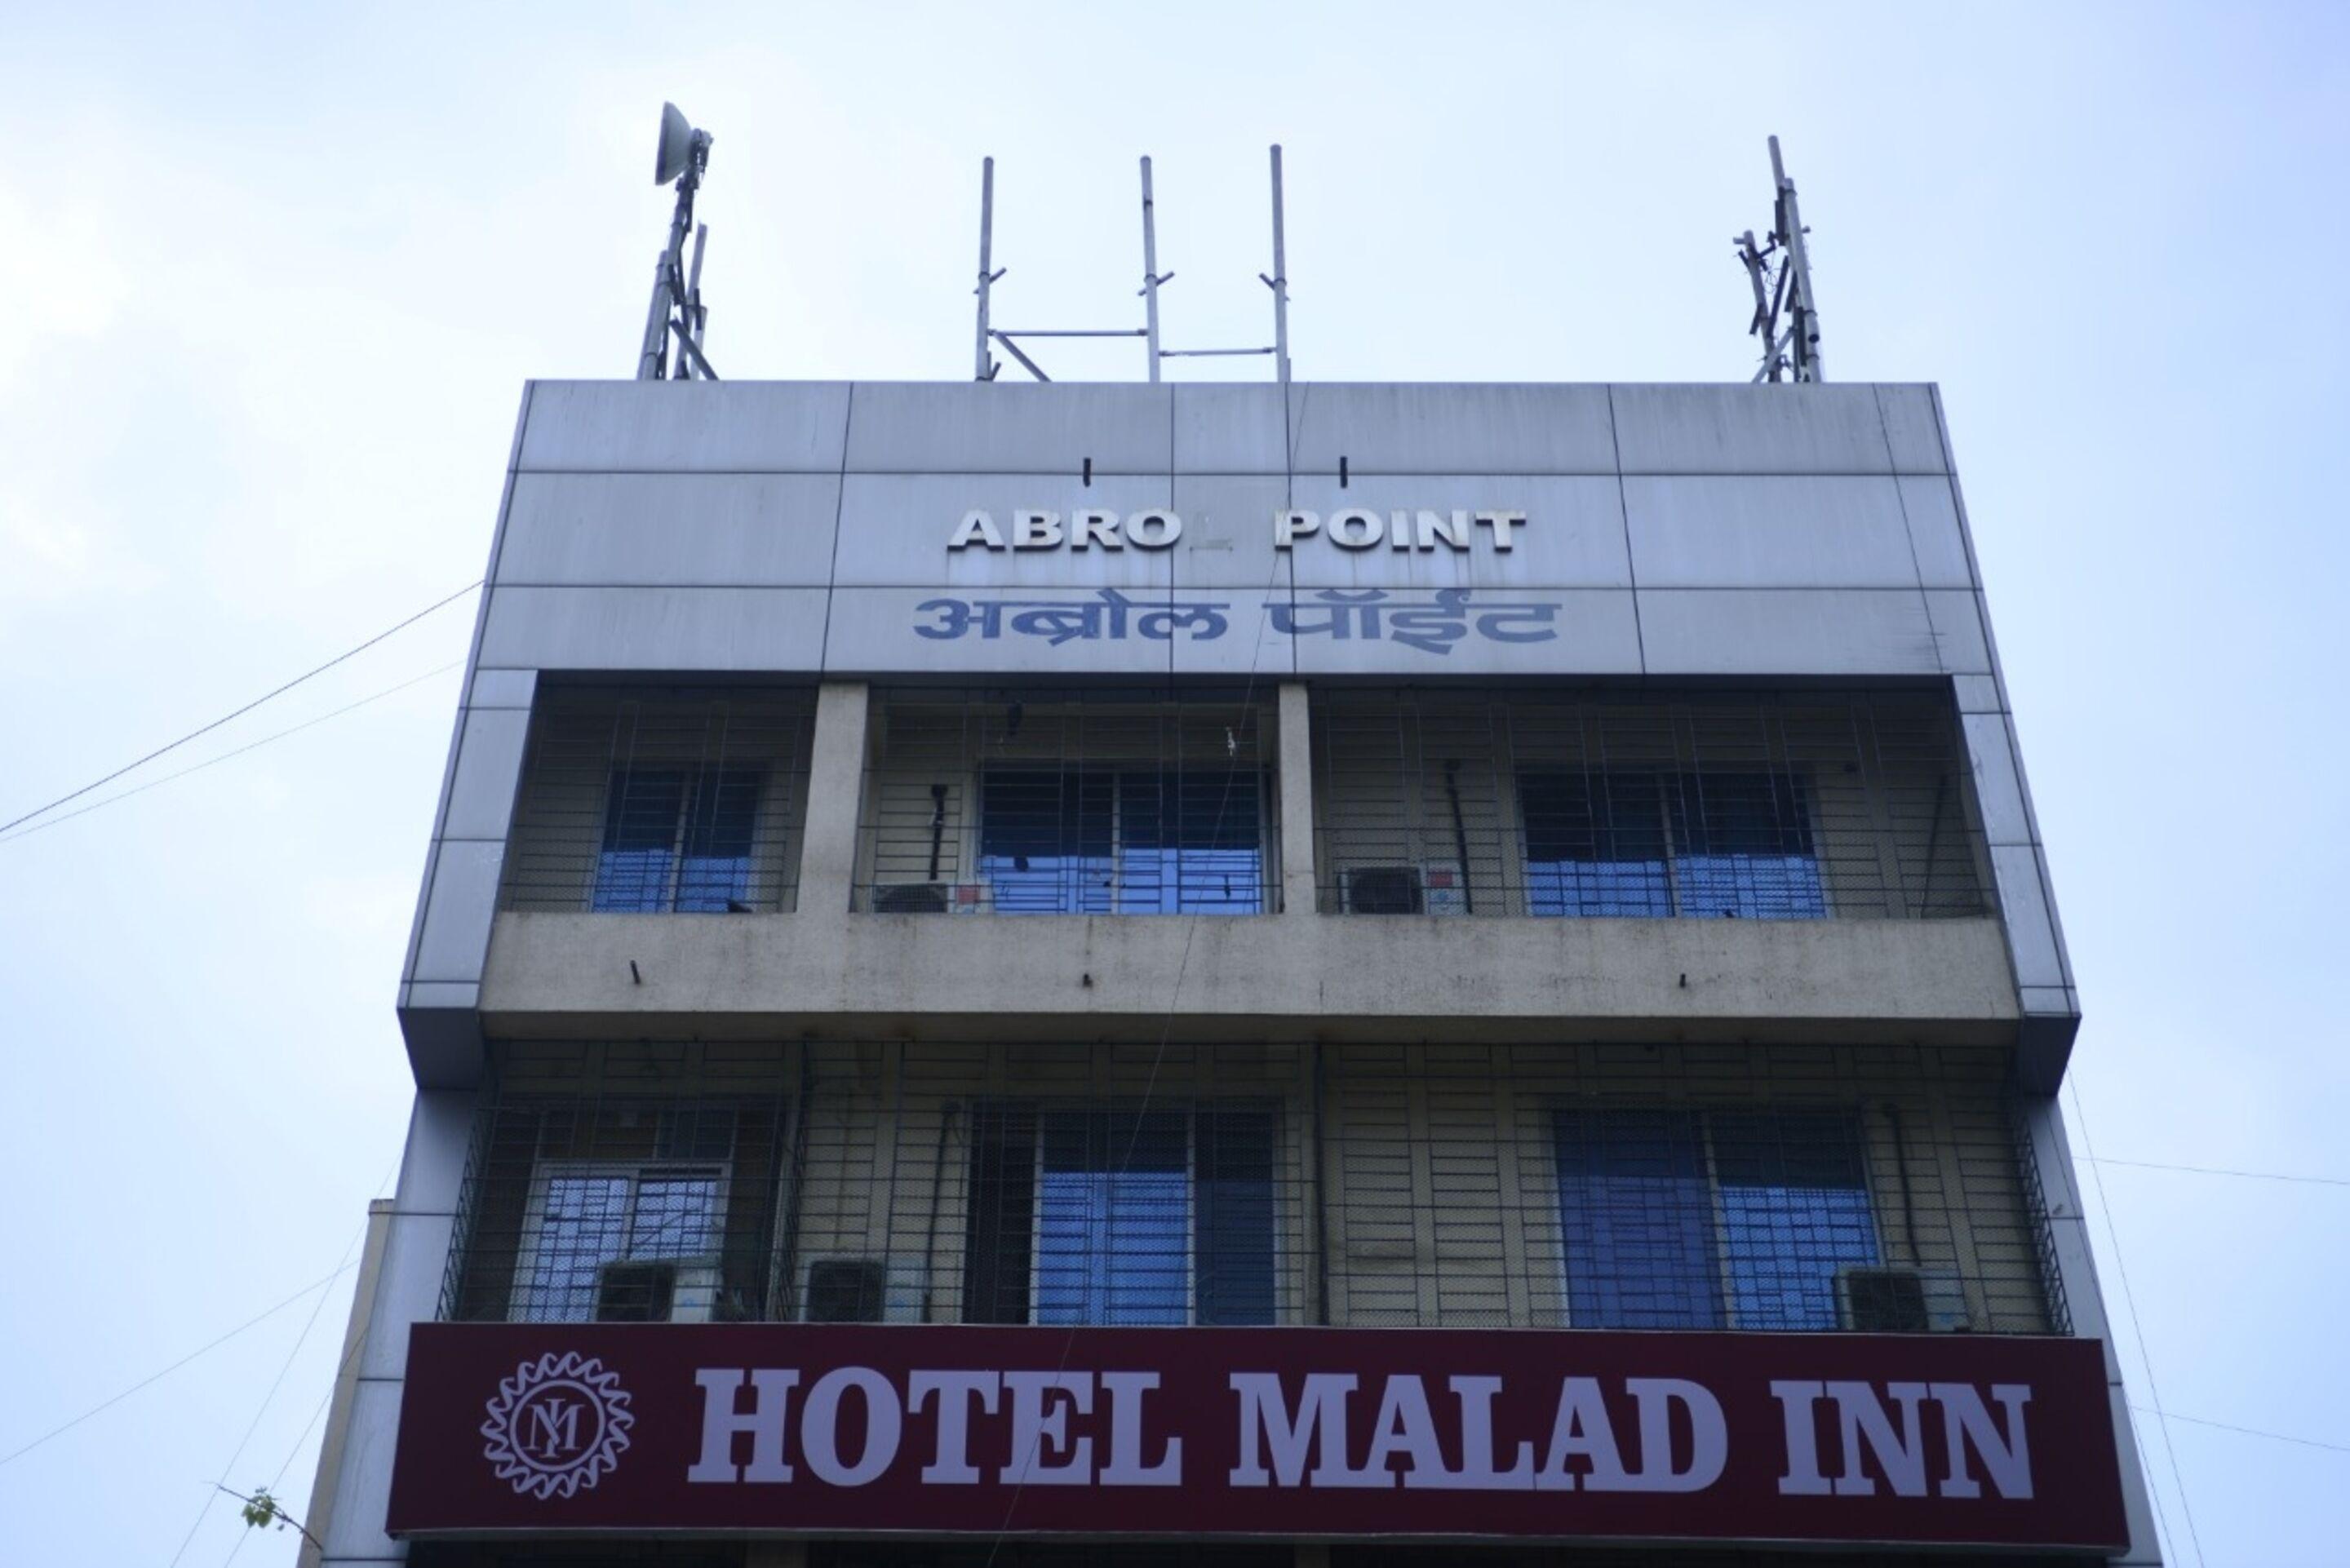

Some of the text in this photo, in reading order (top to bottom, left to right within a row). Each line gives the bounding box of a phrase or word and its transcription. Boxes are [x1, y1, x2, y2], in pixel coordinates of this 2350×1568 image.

[947, 507, 1527, 553] ABRO POINT
[913, 587, 1230, 647] अब्रोल
[687, 1366, 2033, 1499] HOTEL MALAD INN
